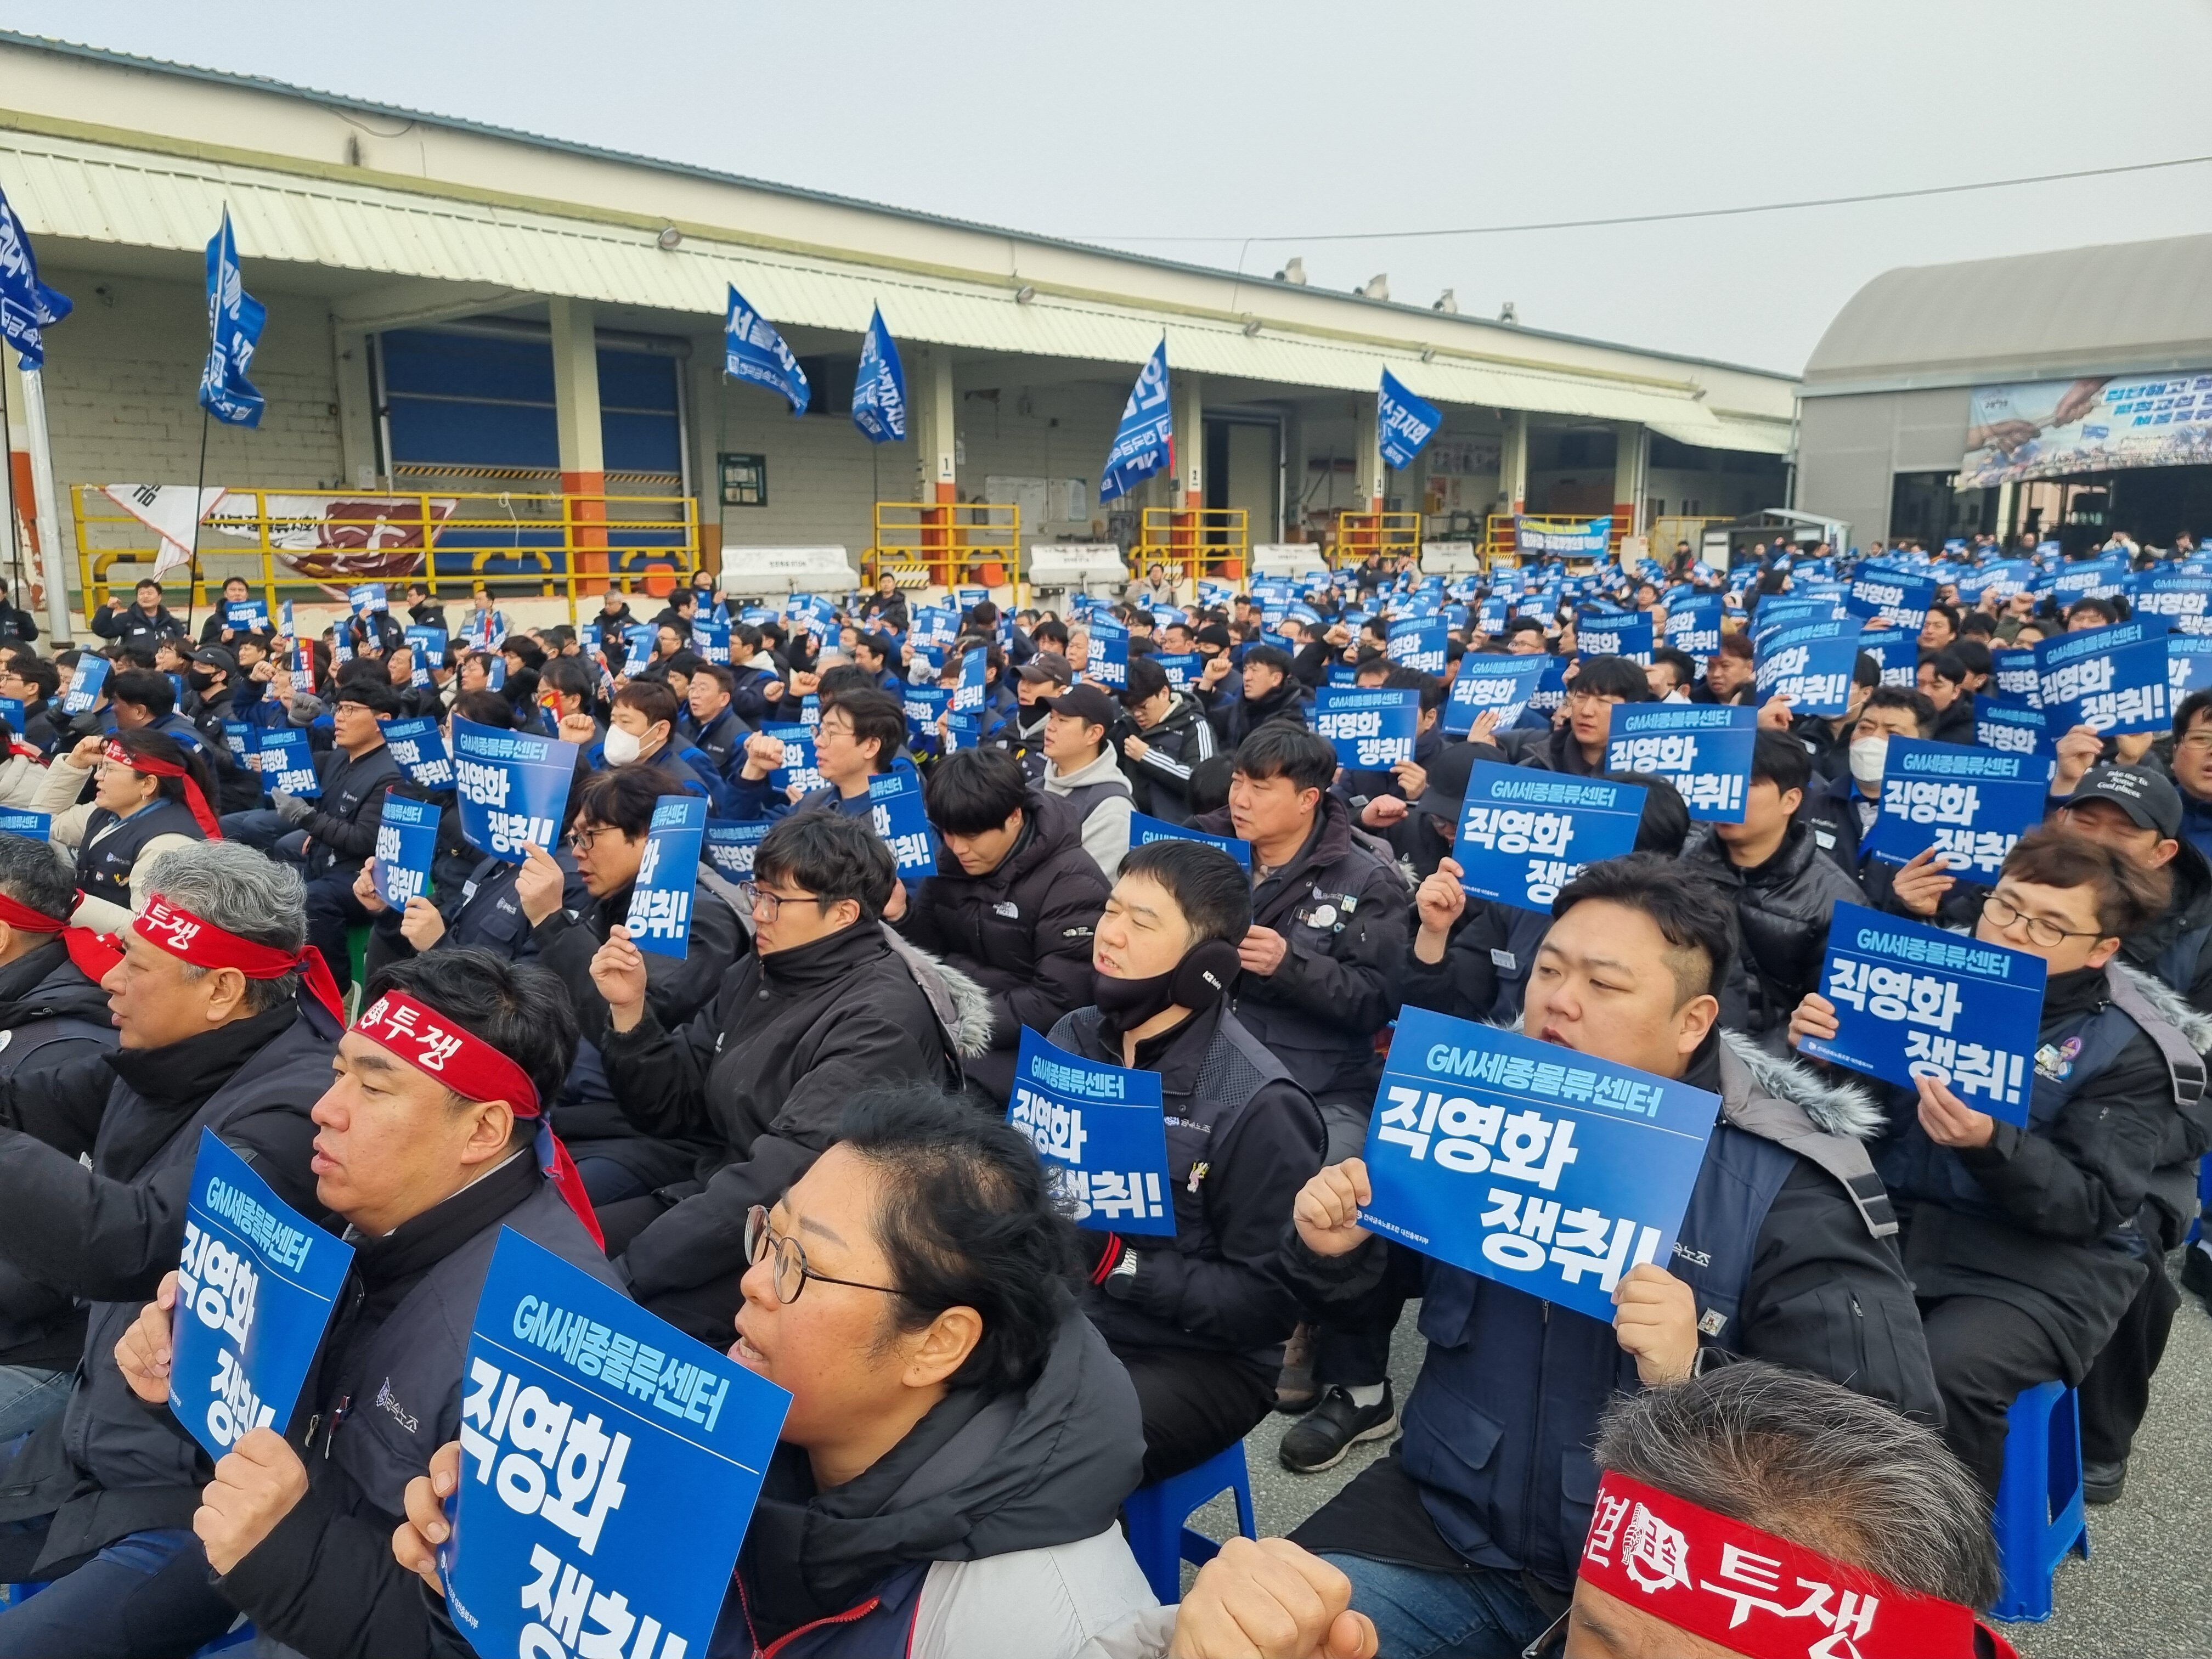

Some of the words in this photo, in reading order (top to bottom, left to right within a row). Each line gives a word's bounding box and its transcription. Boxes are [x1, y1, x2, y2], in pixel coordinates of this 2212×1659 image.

[1852, 581, 1904, 607] 직영화
[2055, 571, 2102, 591] 직영화
[1878, 606, 1926, 630] 쟁취!
[2138, 592, 2208, 615] 직영화
[1386, 633, 1423, 659] 직영화
[1577, 632, 1622, 655] 직영화
[1675, 630, 1718, 652] 쟁취!
[2047, 624, 2142, 665] GM세종물류센터
[1088, 660, 1125, 684] 쟁취!
[1472, 657, 1538, 674] GM세종물류센터
[1756, 645, 1810, 693] 직영화
[2040, 656, 2115, 706] 직영화
[1328, 691, 1403, 708] GM세종물류센터
[1452, 678, 1517, 706] 직영화
[1774, 674, 1848, 707] 쟁취!
[2080, 683, 2165, 732] 쟁취!
[1317, 712, 1383, 740] 직영화
[1625, 709, 1731, 731] GM세종물류센터
[1977, 721, 2038, 755] 직영화
[260, 748, 289, 773] 직영화
[460, 733, 549, 761] GM세종물류센터
[1356, 737, 1412, 766] 쟁취!
[1610, 736, 1699, 772] 직영화
[1903, 753, 2020, 777] GM세종물류센터
[276, 769, 317, 795] 쟁취!
[410, 759, 454, 788] 쟁취!
[455, 759, 510, 809] 직영화
[1491, 779, 1617, 808] GM세종물류센터
[1883, 781, 1980, 827] 직영화
[1464, 808, 1573, 856] 직영화
[1932, 828, 2020, 872] 쟁취
[387, 864, 423, 903] 쟁취!
[144, 904, 201, 951] 투쟁
[626, 888, 689, 939] 쟁취!
[1857, 928, 2011, 978] GM세종물류센터
[1202, 970, 1215, 983] K2
[1829, 957, 1963, 1032] 직영화
[384, 1006, 463, 1071] 투쟁
[1031, 1055, 1125, 1099] GM세종물류센터
[1427, 1042, 1663, 1118] GM세종물류센터
[1904, 1029, 2025, 1104] 쟁취!
[1011, 1088, 1087, 1164] 직영화
[1181, 1118, 1212, 1133] 금속노조
[1378, 1085, 1578, 1190] 직영화
[206, 1176, 313, 1274] GM세종물류센터
[1364, 1213, 1400, 1234] 전국금속노동조합
[1401, 1228, 1429, 1245] 대전충북지부
[1480, 1189, 1661, 1293] 쟁취!
[176, 1221, 259, 1355] 직영화
[514, 1295, 729, 1432] GM세종물류센터
[386, 1393, 419, 1434] 금속노조
[460, 1356, 631, 1556] 직영화
[1584, 1487, 1629, 1567] 결
[1700, 1543, 1879, 1659] 투쟁
